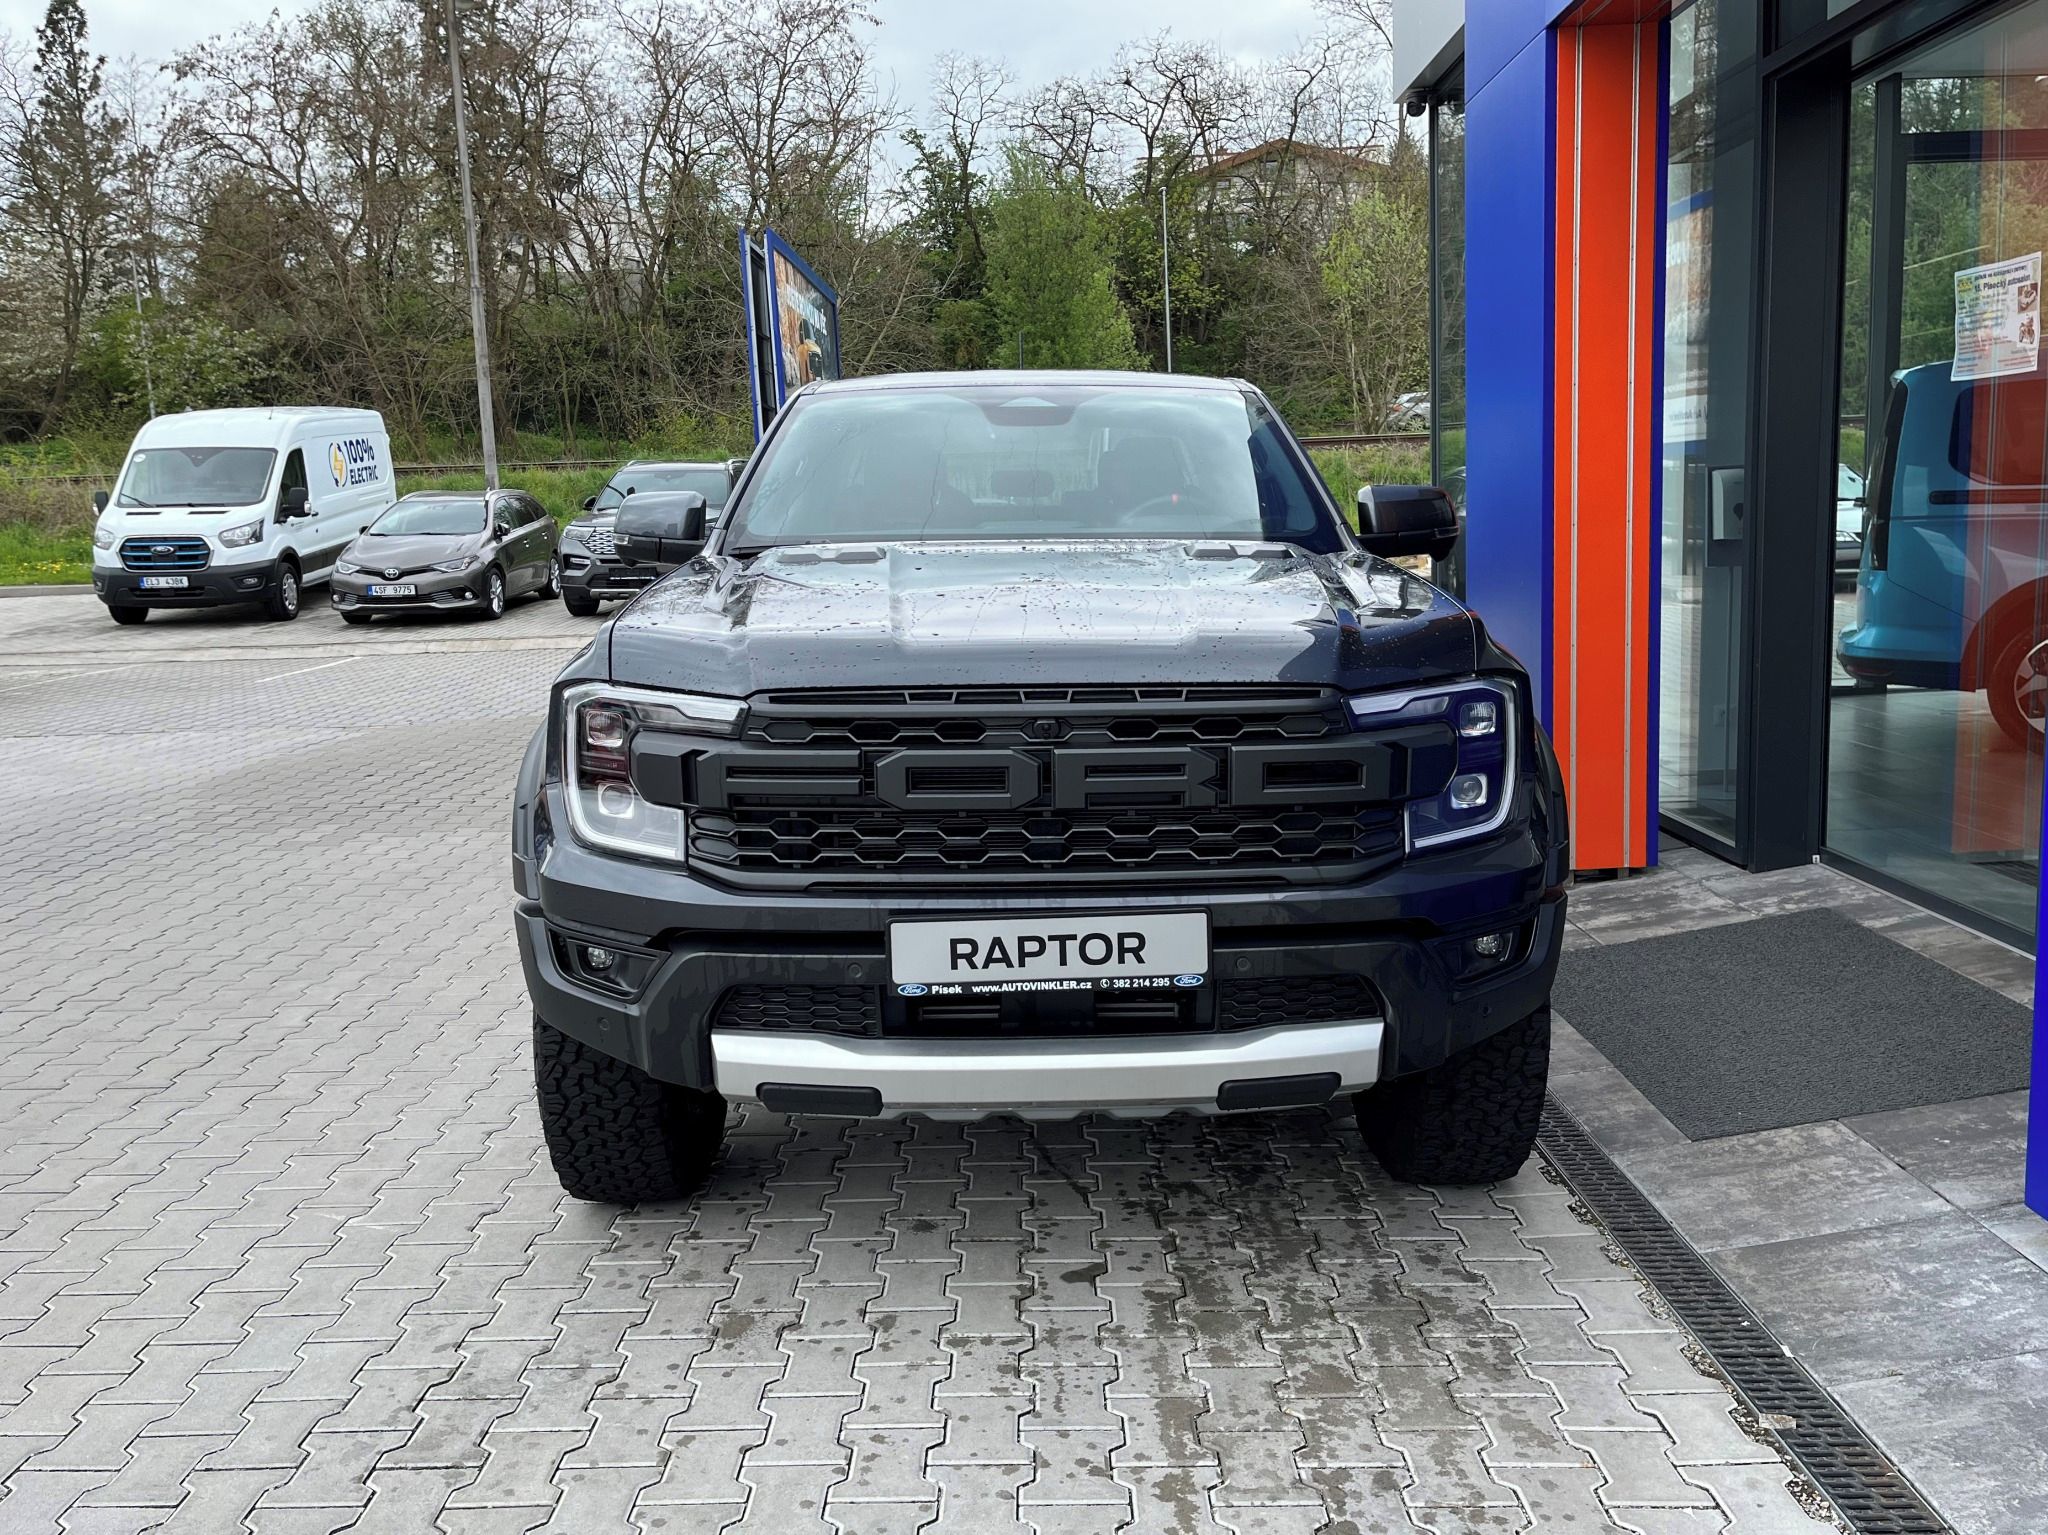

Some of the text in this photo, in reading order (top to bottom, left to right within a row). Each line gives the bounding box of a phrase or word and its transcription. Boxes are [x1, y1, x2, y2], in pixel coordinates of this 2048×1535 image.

[343, 438, 375, 464] 100%
[350, 464, 379, 486] ELECTRIC
[374, 585, 412, 594] 4SF 9775
[696, 741, 1389, 811] FORD
[949, 931, 1147, 971] RAPTOR
[971, 980, 1093, 993] www.AUTOVINKLER.cz
[1113, 979, 1130, 988] 382
[1132, 978, 1150, 987] 214
[1152, 978, 1170, 987] 295
